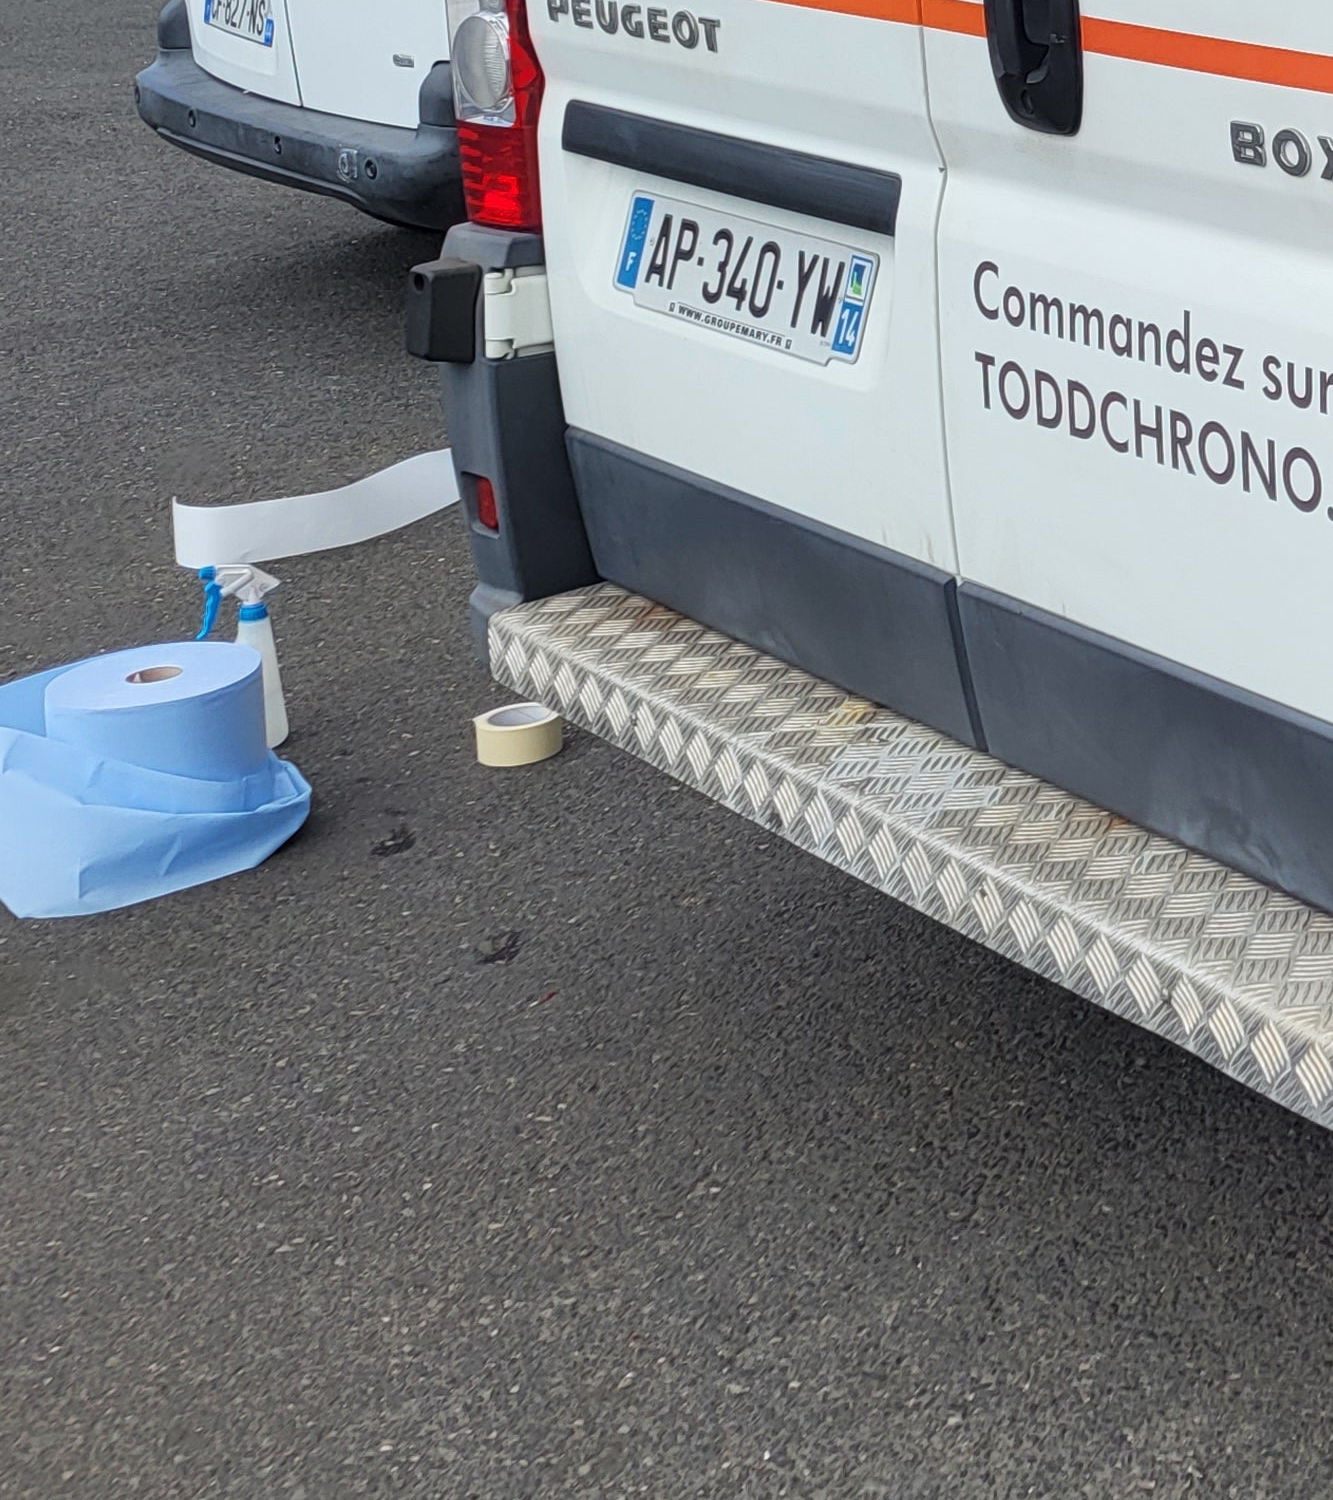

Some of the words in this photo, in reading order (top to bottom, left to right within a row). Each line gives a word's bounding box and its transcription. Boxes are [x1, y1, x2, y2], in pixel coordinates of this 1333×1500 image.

[625, 252, 636, 271] F
[677, 304, 783, 348] WWW.GROUPEMARY.FR
[839, 308, 858, 347] 14
[972, 261, 1246, 392] Commandez
